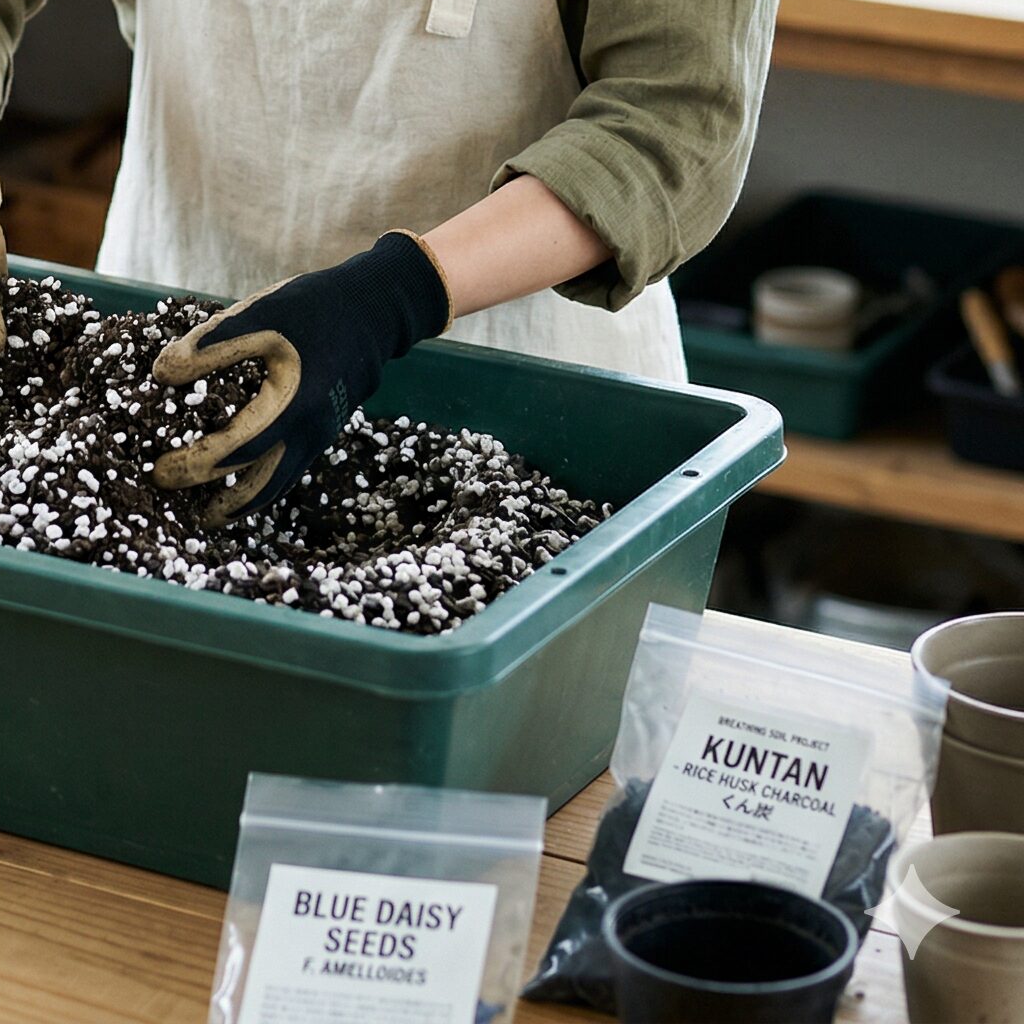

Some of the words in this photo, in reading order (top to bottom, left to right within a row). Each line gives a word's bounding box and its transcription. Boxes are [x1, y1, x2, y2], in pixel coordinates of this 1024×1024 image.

[701, 734, 829, 791] KUNTAN
[683, 762, 717, 784] RICE
[718, 772, 759, 796] HUSK
[761, 785, 836, 817] CHARCOAL
[722, 794, 774, 821] くん炭
[294, 890, 368, 922] BLUE
[376, 898, 463, 931] DAISY
[325, 927, 417, 960] SEEDS
[321, 960, 428, 985] AMELLOIDES
